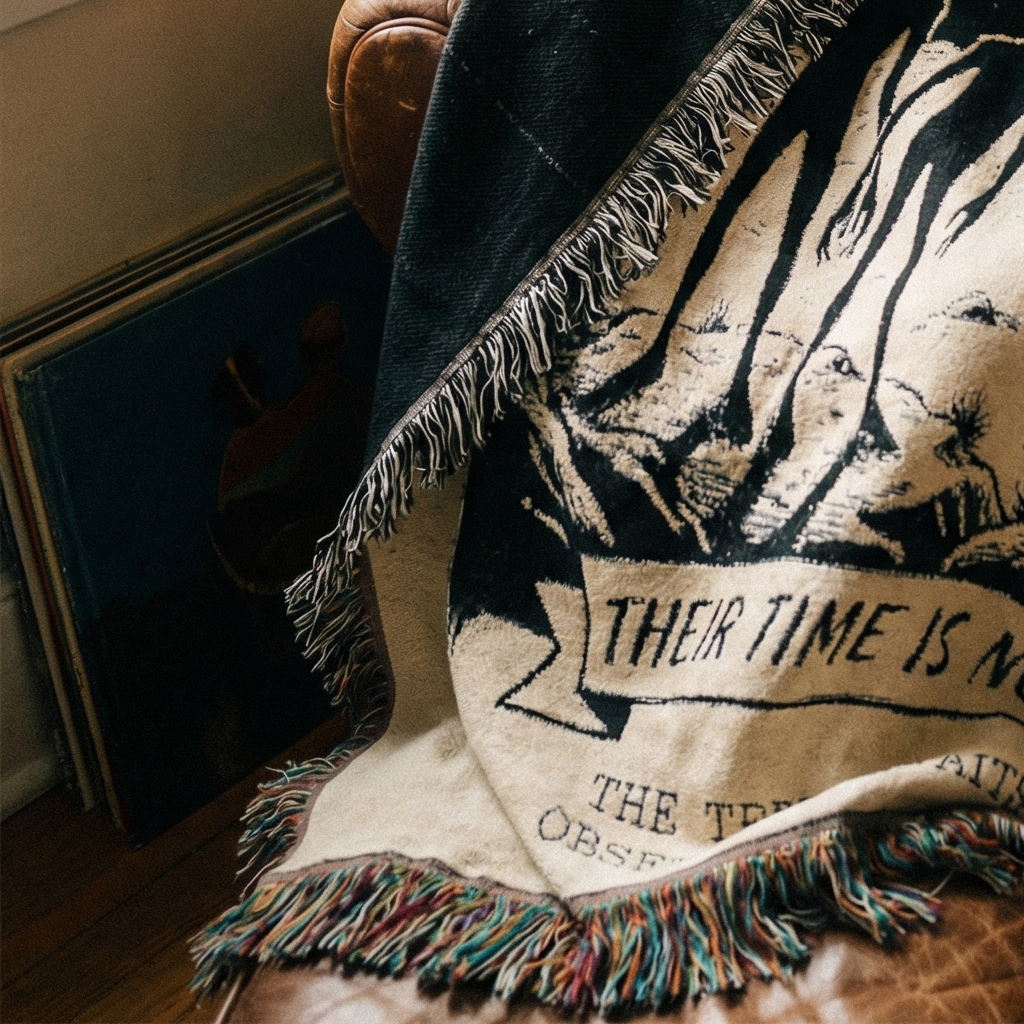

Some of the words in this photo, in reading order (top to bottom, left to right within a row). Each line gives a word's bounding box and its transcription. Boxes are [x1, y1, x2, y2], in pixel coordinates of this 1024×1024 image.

[604, 595, 745, 668] THEIR
[746, 593, 910, 668] TIME
[902, 607, 972, 674] IS
[588, 773, 678, 836] THE
